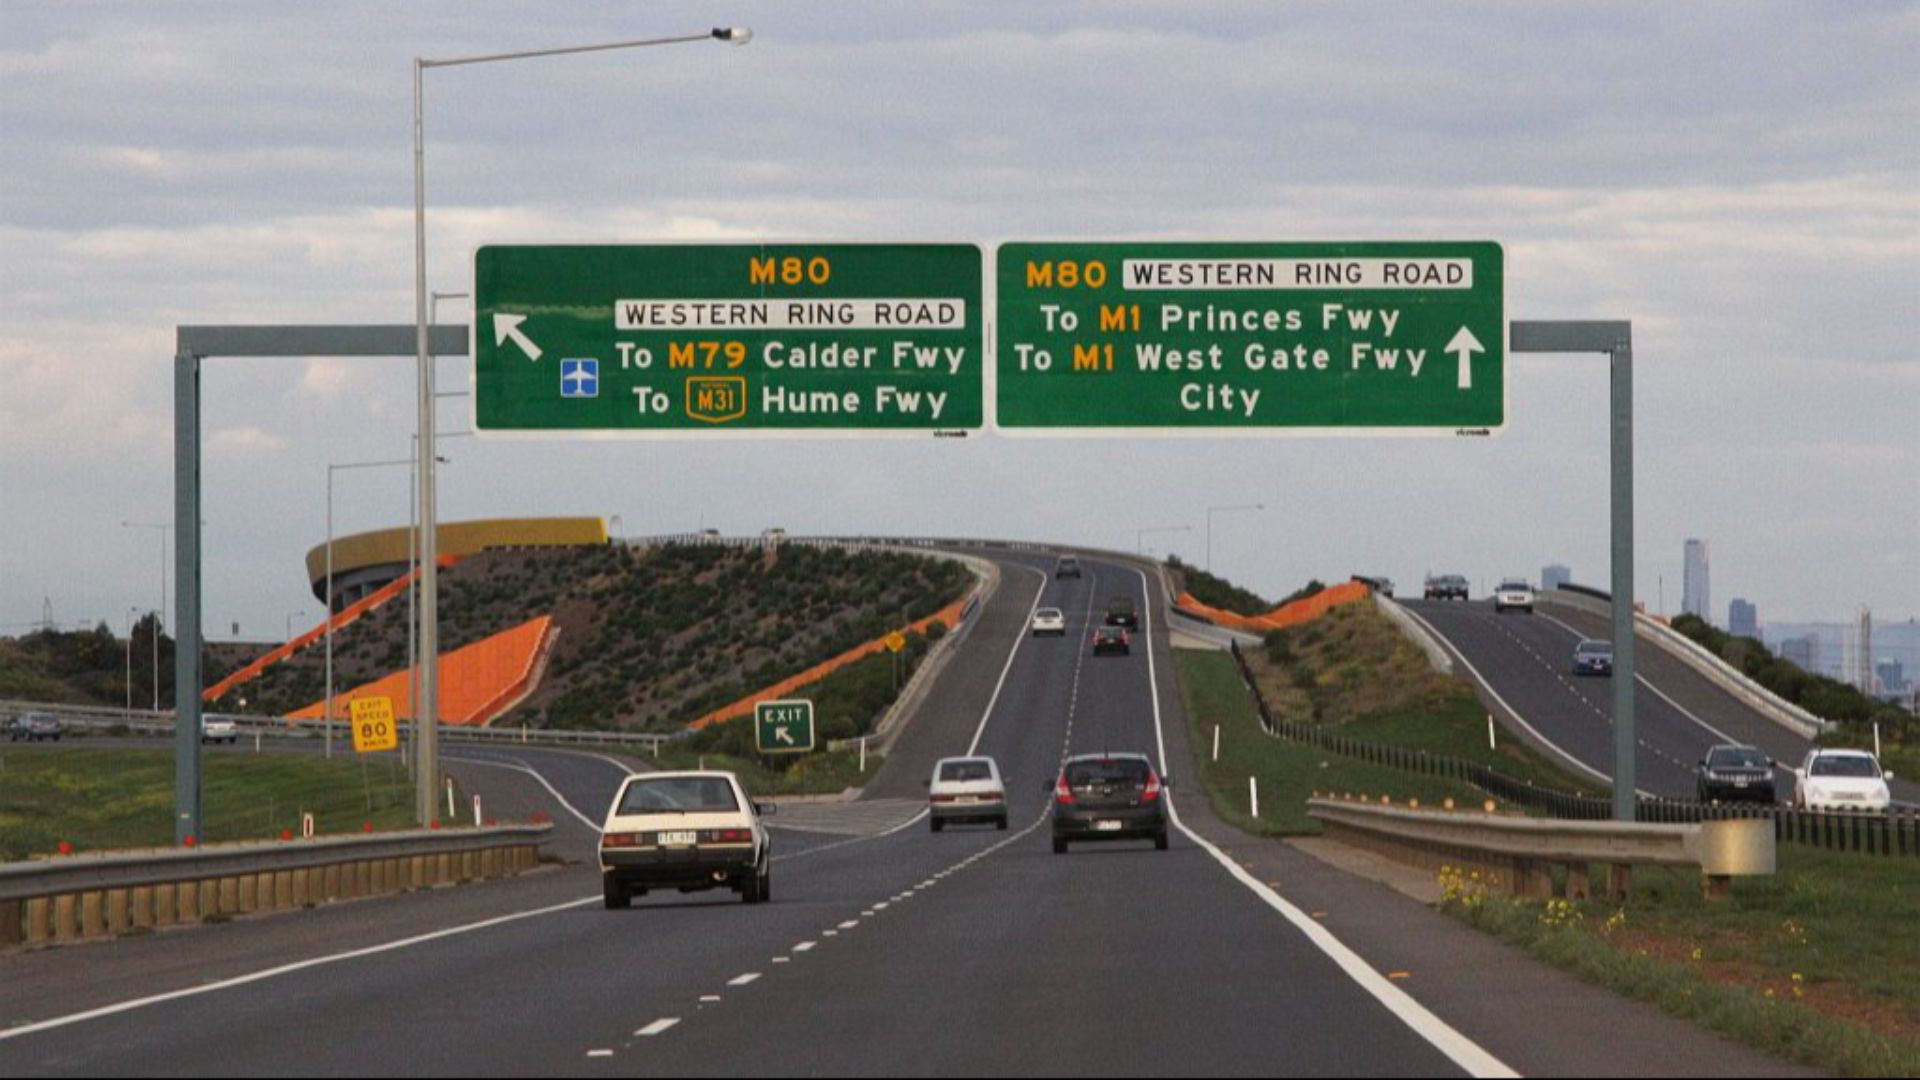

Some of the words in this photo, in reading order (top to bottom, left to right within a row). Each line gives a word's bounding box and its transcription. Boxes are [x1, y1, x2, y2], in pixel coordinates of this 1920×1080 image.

[750, 257, 831, 285] M80
[1026, 261, 1107, 288] M80
[1133, 263, 1274, 285] WESTERN
[1296, 263, 1362, 284] RING
[1384, 263, 1464, 284] ROAD
[625, 304, 768, 325] WESTERN
[788, 303, 855, 325] RING
[875, 303, 956, 325] ROAD
[1040, 305, 1079, 331] To
[1100, 305, 1141, 331] M1
[1161, 304, 1302, 331] Princes
[1322, 303, 1400, 336] Fwy
[615, 342, 653, 369] To
[669, 342, 747, 369] M79
[763, 341, 878, 369] Calder
[893, 342, 965, 374] Fwy
[1014, 344, 1052, 370] To
[1073, 344, 1114, 370] M1
[1136, 344, 1222, 370] West
[1245, 343, 1330, 370] Gate
[1351, 343, 1427, 376] Fwy
[632, 386, 670, 413] To
[699, 389, 733, 411] M31
[762, 386, 860, 413] Hume
[876, 386, 948, 419] Fwy
[1181, 383, 1261, 416] City
[361, 721, 387, 739] 80
[764, 707, 803, 723] EXIT
